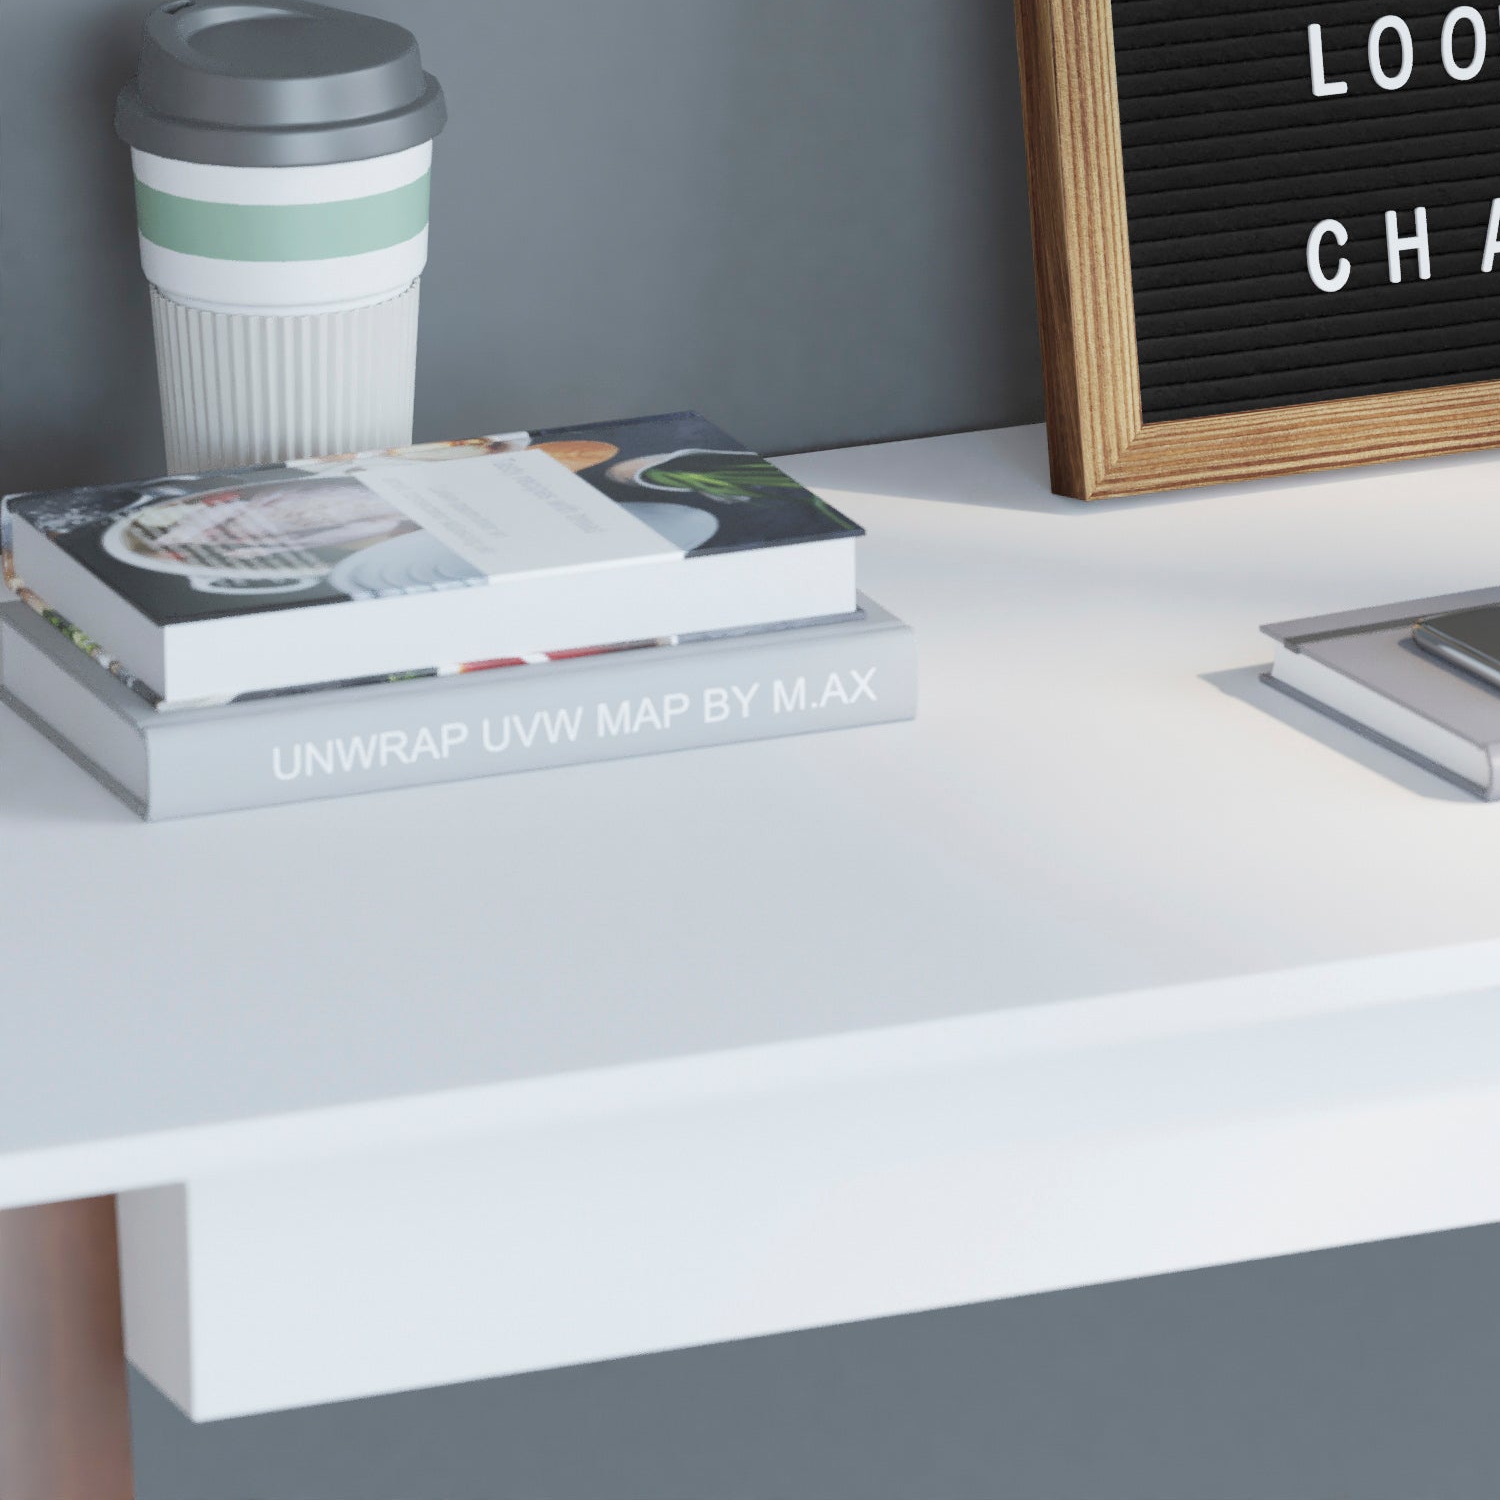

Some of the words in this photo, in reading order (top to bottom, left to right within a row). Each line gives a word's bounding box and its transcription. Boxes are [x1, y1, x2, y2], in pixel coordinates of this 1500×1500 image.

[272, 722, 469, 781] UNWRAP
[482, 707, 583, 753] UVW
[597, 692, 690, 738] MAP
[703, 682, 760, 724] BY
[773, 666, 878, 714] M.AX
